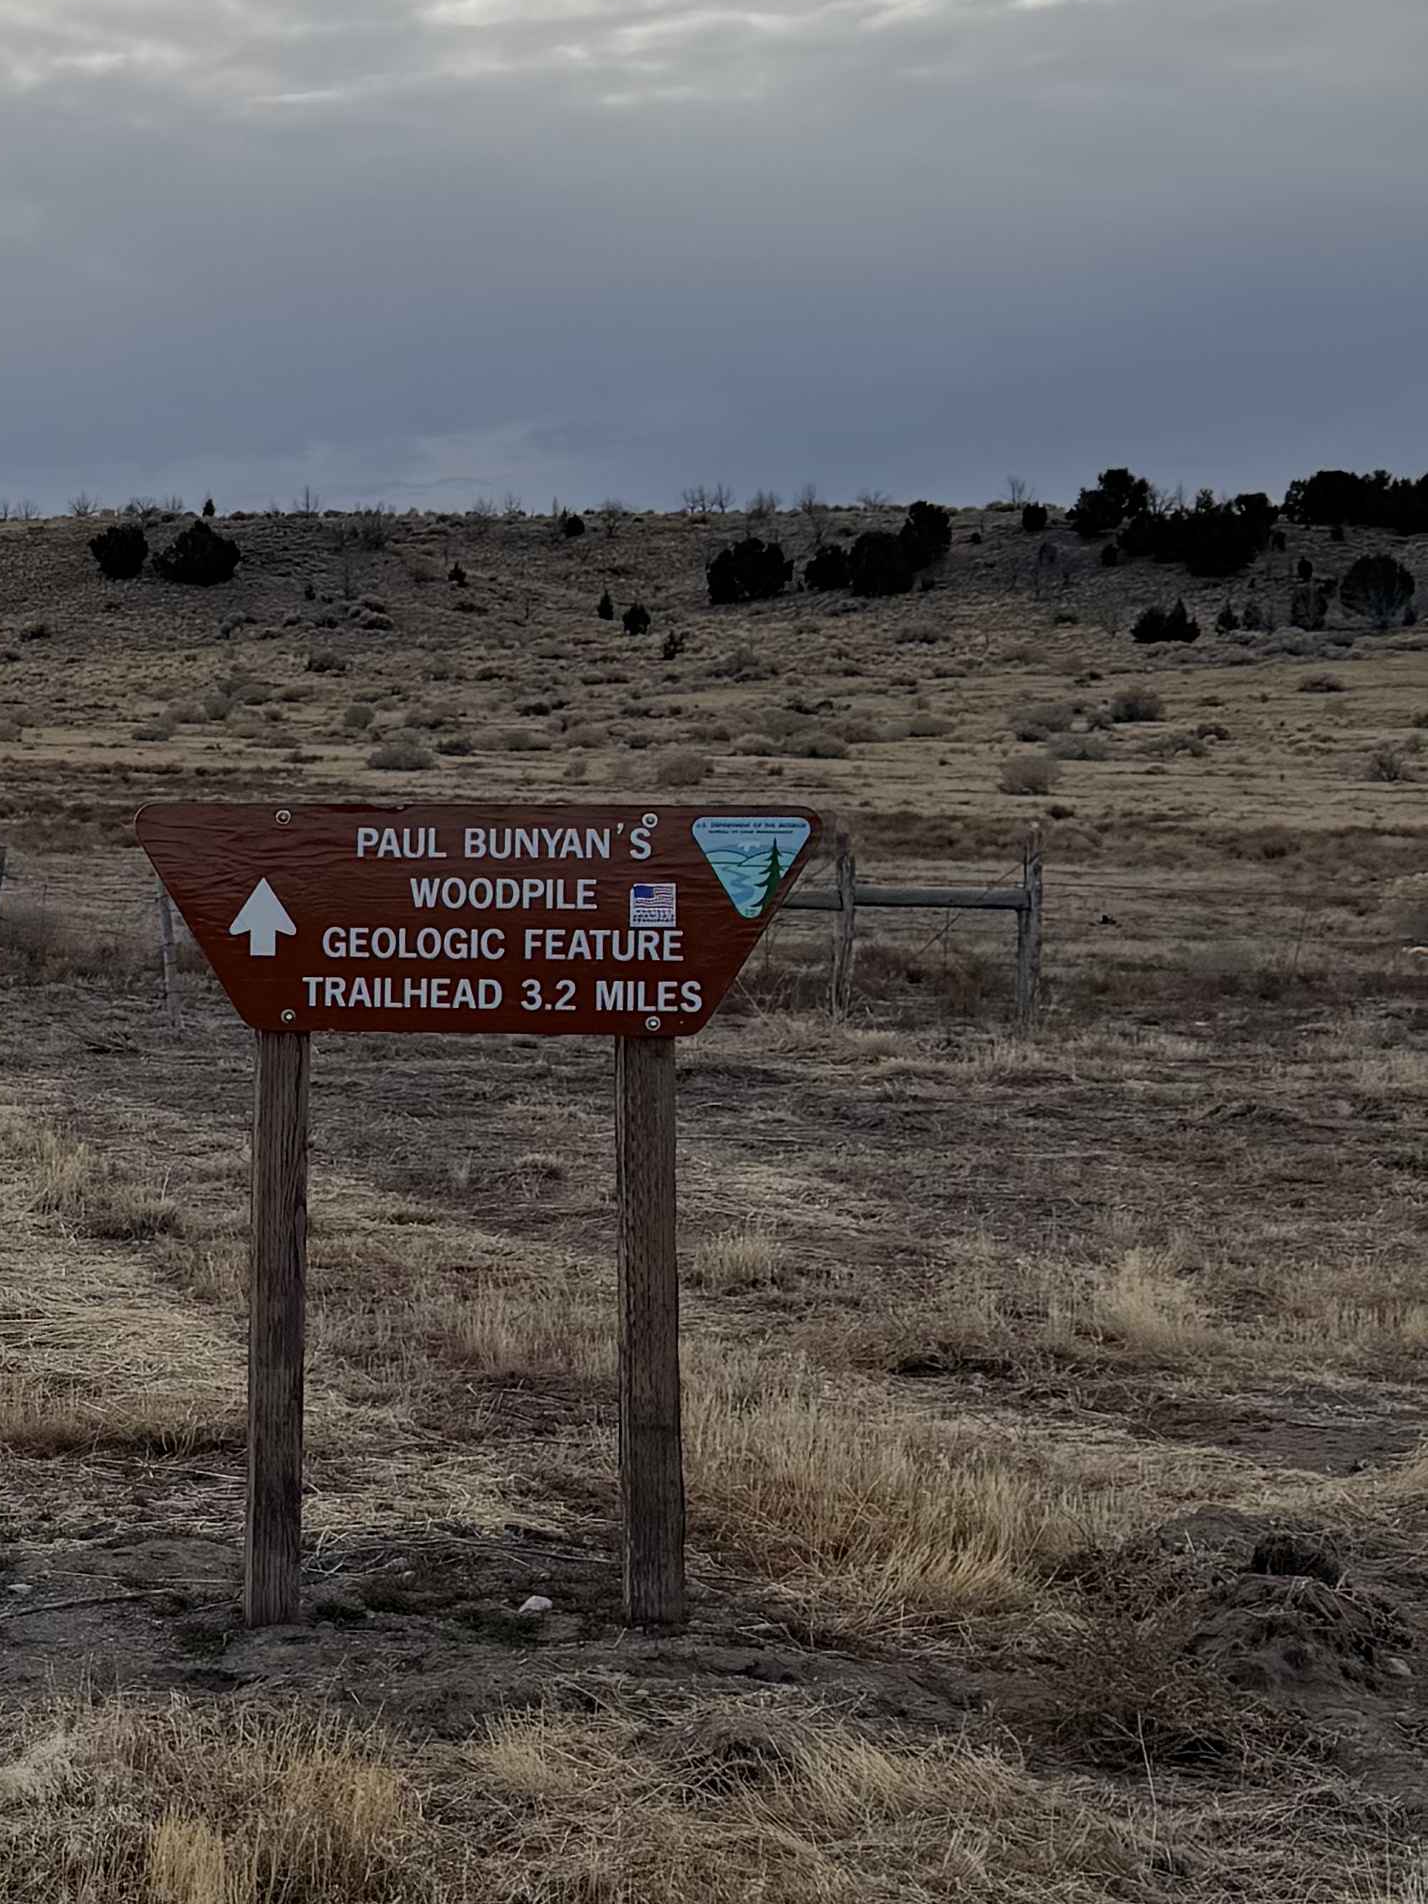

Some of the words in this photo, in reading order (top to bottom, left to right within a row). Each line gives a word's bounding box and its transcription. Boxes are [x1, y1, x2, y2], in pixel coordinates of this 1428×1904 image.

[356, 827, 447, 859] PAUL
[463, 822, 652, 860] BUNYAN'S
[409, 877, 598, 910] WOODPILE
[321, 926, 506, 960] GEOLOGIC
[524, 929, 684, 962] FEATURE
[302, 976, 503, 1010] TRAILHEAD
[519, 979, 578, 1011] 3.2
[595, 980, 703, 1013] MILES
